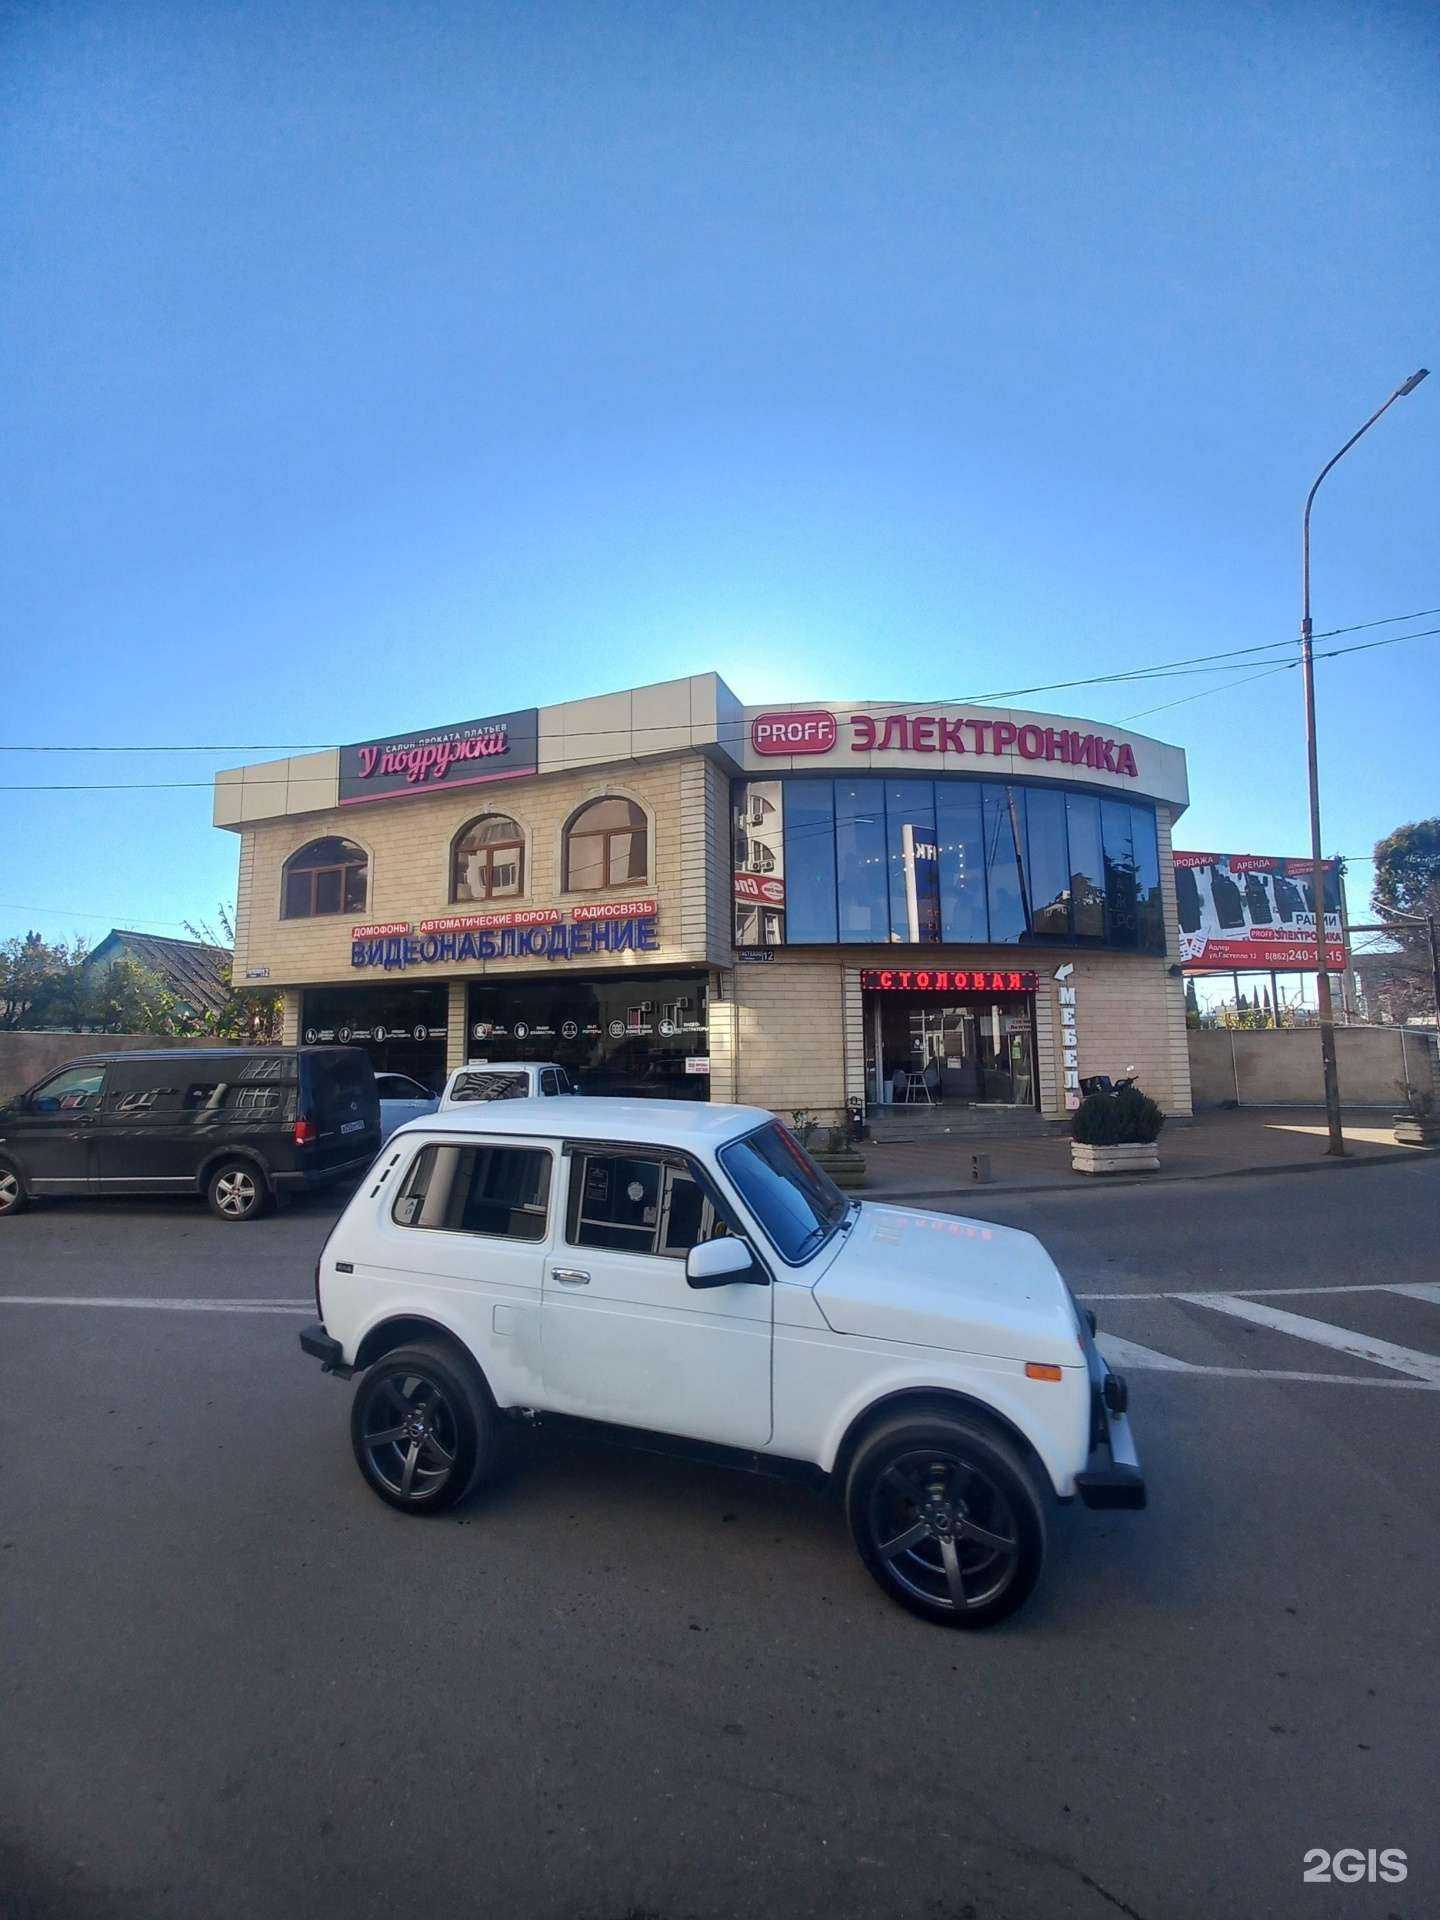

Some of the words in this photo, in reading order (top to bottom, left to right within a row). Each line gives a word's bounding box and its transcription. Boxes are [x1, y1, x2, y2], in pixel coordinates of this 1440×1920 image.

[385, 743, 415, 753] САЛОН
[418, 733, 460, 746] ПРОКАТА
[464, 723, 507, 738] ПЛАТЬЕВ
[850, 715, 1138, 777] ЭЛЕКТРОНИКА
[358, 745, 377, 778] У
[380, 733, 508, 783] подружки
[1236, 858, 1271, 870] АРЕНДА
[420, 913, 512, 931] АВТОМАТИЧЕСКИЕ
[514, 910, 558, 923] ВОРОТА
[574, 902, 652, 919] РАДИОСВЯЗЬ
[353, 924, 409, 938] ДОМОФОНЫ
[351, 917, 661, 971] ВИДЕОНАБЛЮДЕНИЕ
[881, 972, 1022, 988] СТОЛОВАЯ
[1059, 987, 1080, 1110] МЕБЕЛЬ
